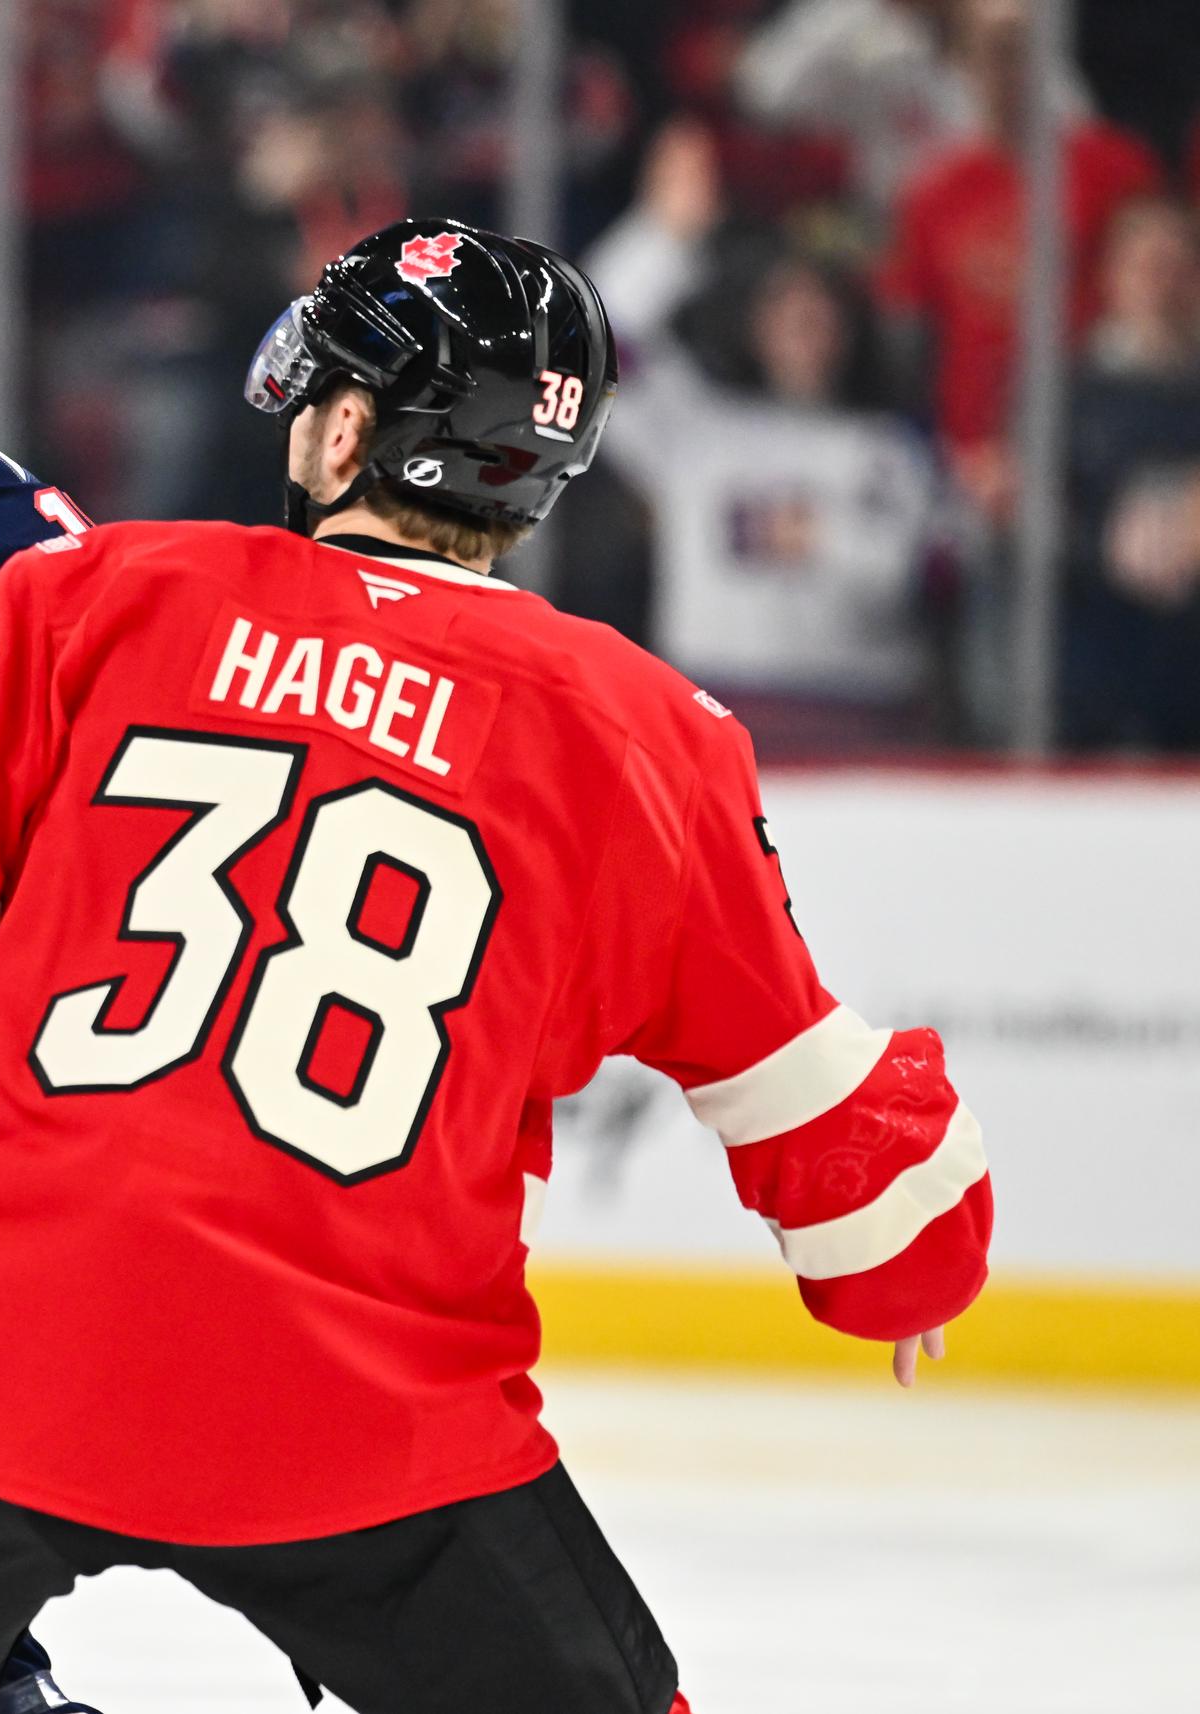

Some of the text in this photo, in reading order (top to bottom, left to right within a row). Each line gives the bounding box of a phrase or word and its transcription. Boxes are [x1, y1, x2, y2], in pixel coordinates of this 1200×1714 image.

[532, 369, 584, 431] 38
[209, 616, 456, 777] HAGEL
[27, 724, 504, 1188] 38
